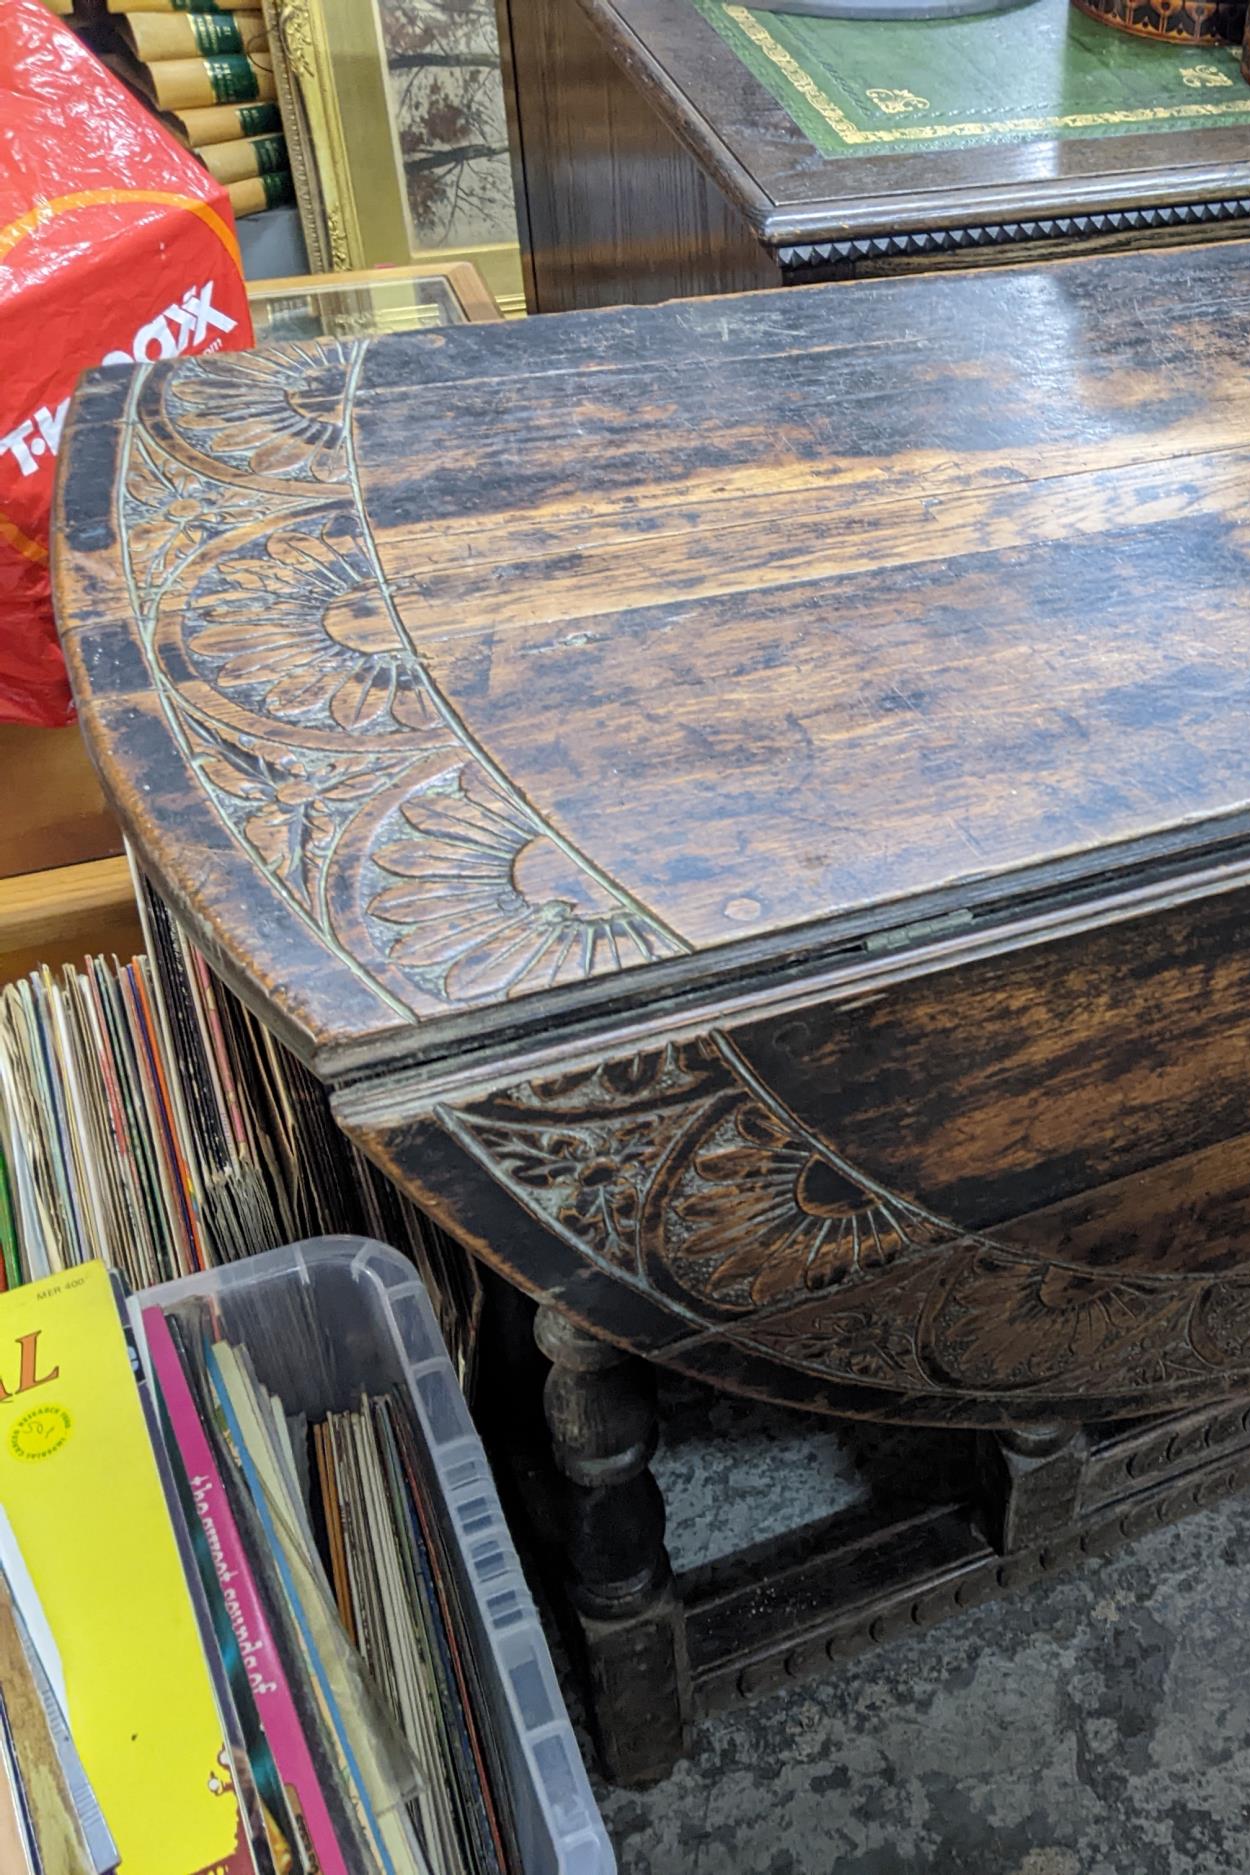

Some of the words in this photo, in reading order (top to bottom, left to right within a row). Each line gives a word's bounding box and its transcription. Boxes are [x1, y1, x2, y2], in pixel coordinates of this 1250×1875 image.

[36, 1286, 62, 1302] MER
[64, 1278, 85, 1291] 400
[190, 1474, 213, 1515] the
[224, 1587, 263, 1671] sounds
[248, 1672, 277, 1696] of
